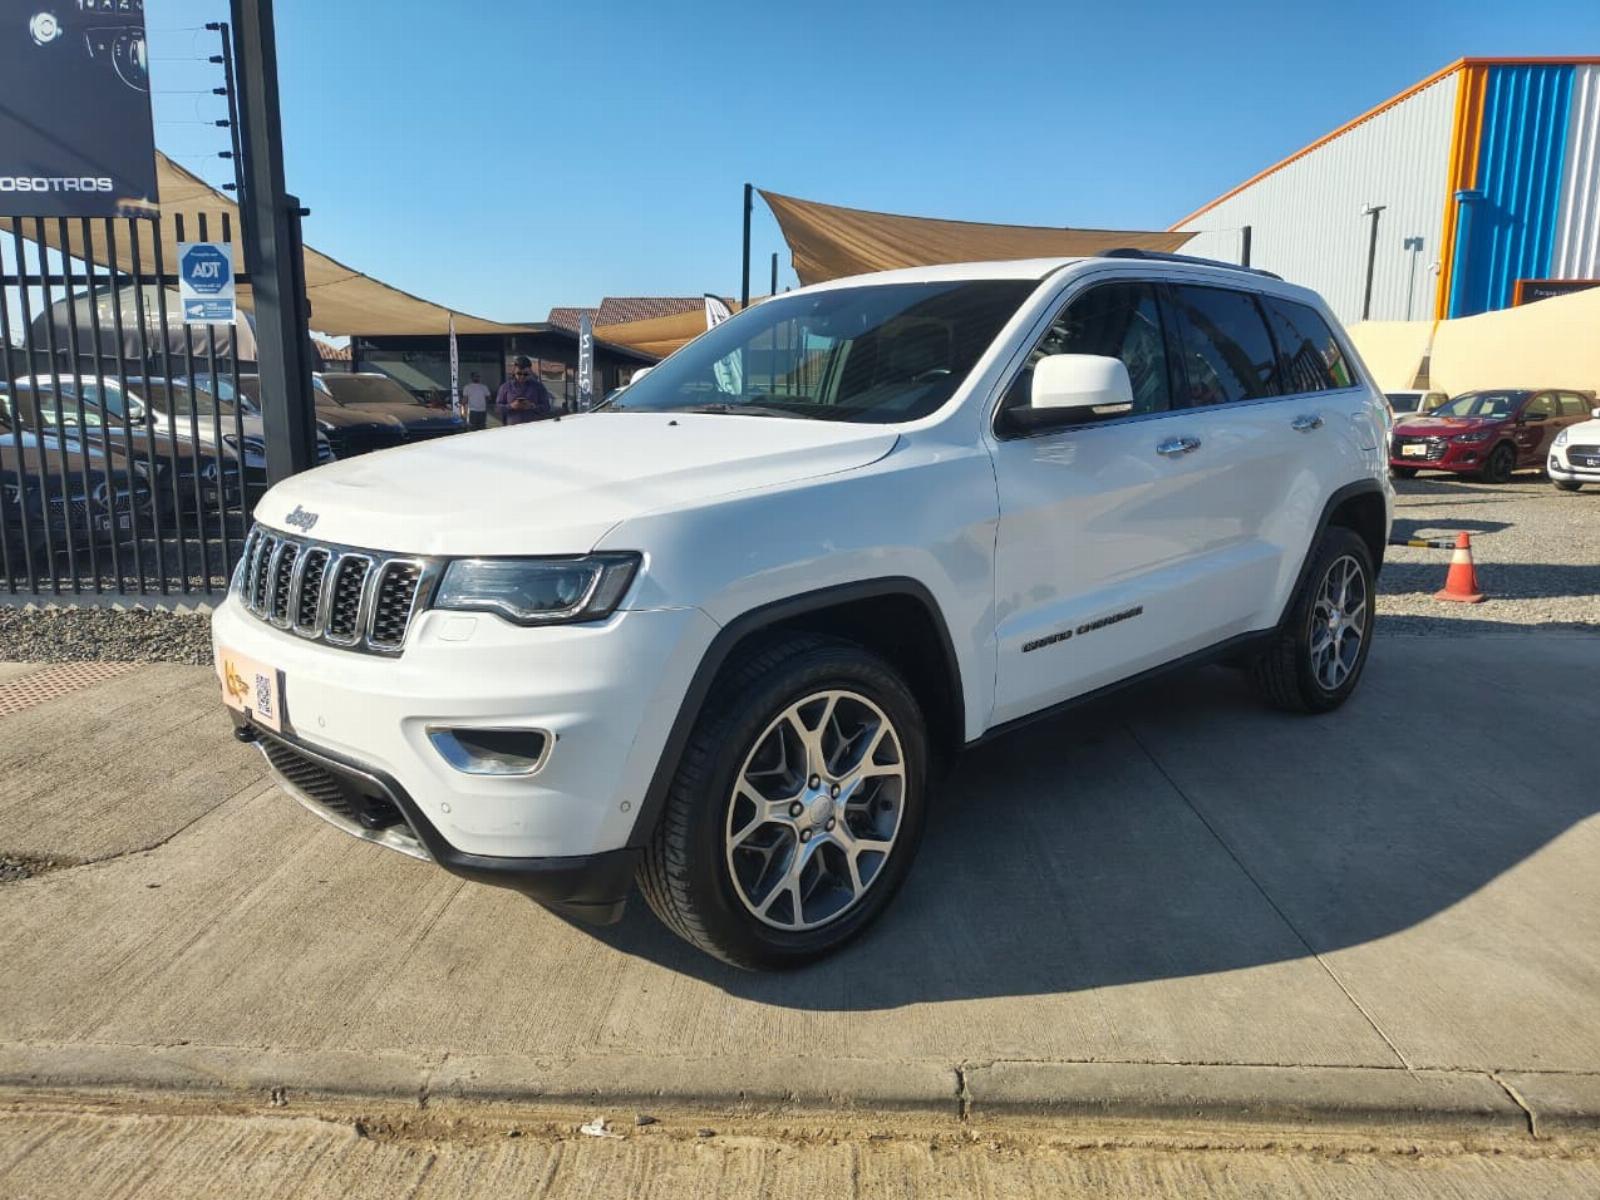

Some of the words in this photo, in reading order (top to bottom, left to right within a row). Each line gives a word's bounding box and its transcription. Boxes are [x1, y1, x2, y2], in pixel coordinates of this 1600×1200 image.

[0, 177, 112, 193] OSOTROS
[191, 261, 221, 278] ADT
[285, 504, 319, 533] Jeep
